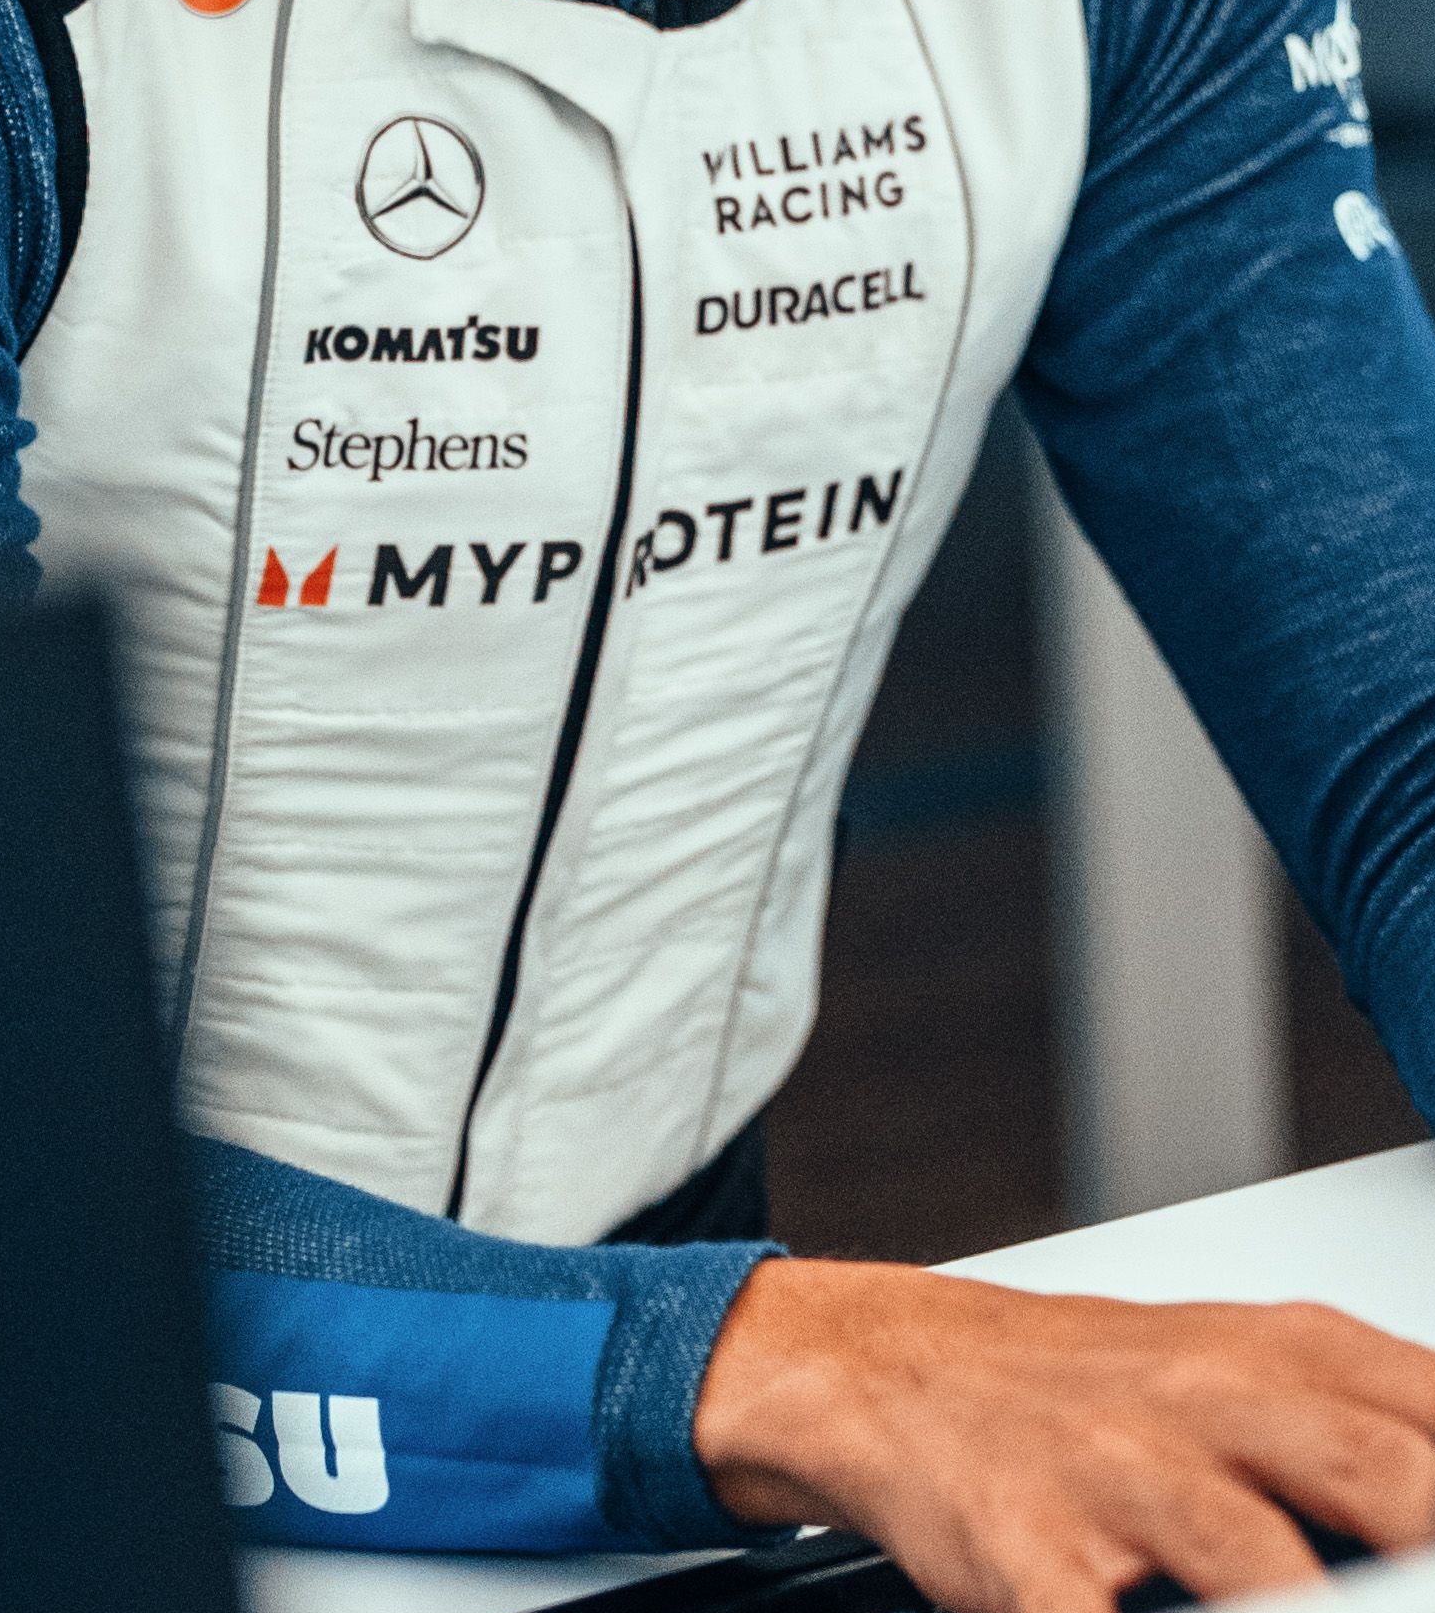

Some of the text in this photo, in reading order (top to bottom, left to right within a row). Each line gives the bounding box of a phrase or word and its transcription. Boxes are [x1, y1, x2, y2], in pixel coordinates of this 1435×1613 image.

[715, 171, 904, 234] RACING
[696, 261, 925, 336] DURACELL
[303, 314, 540, 364] KOMATSU
[286, 417, 529, 482] Stephens
